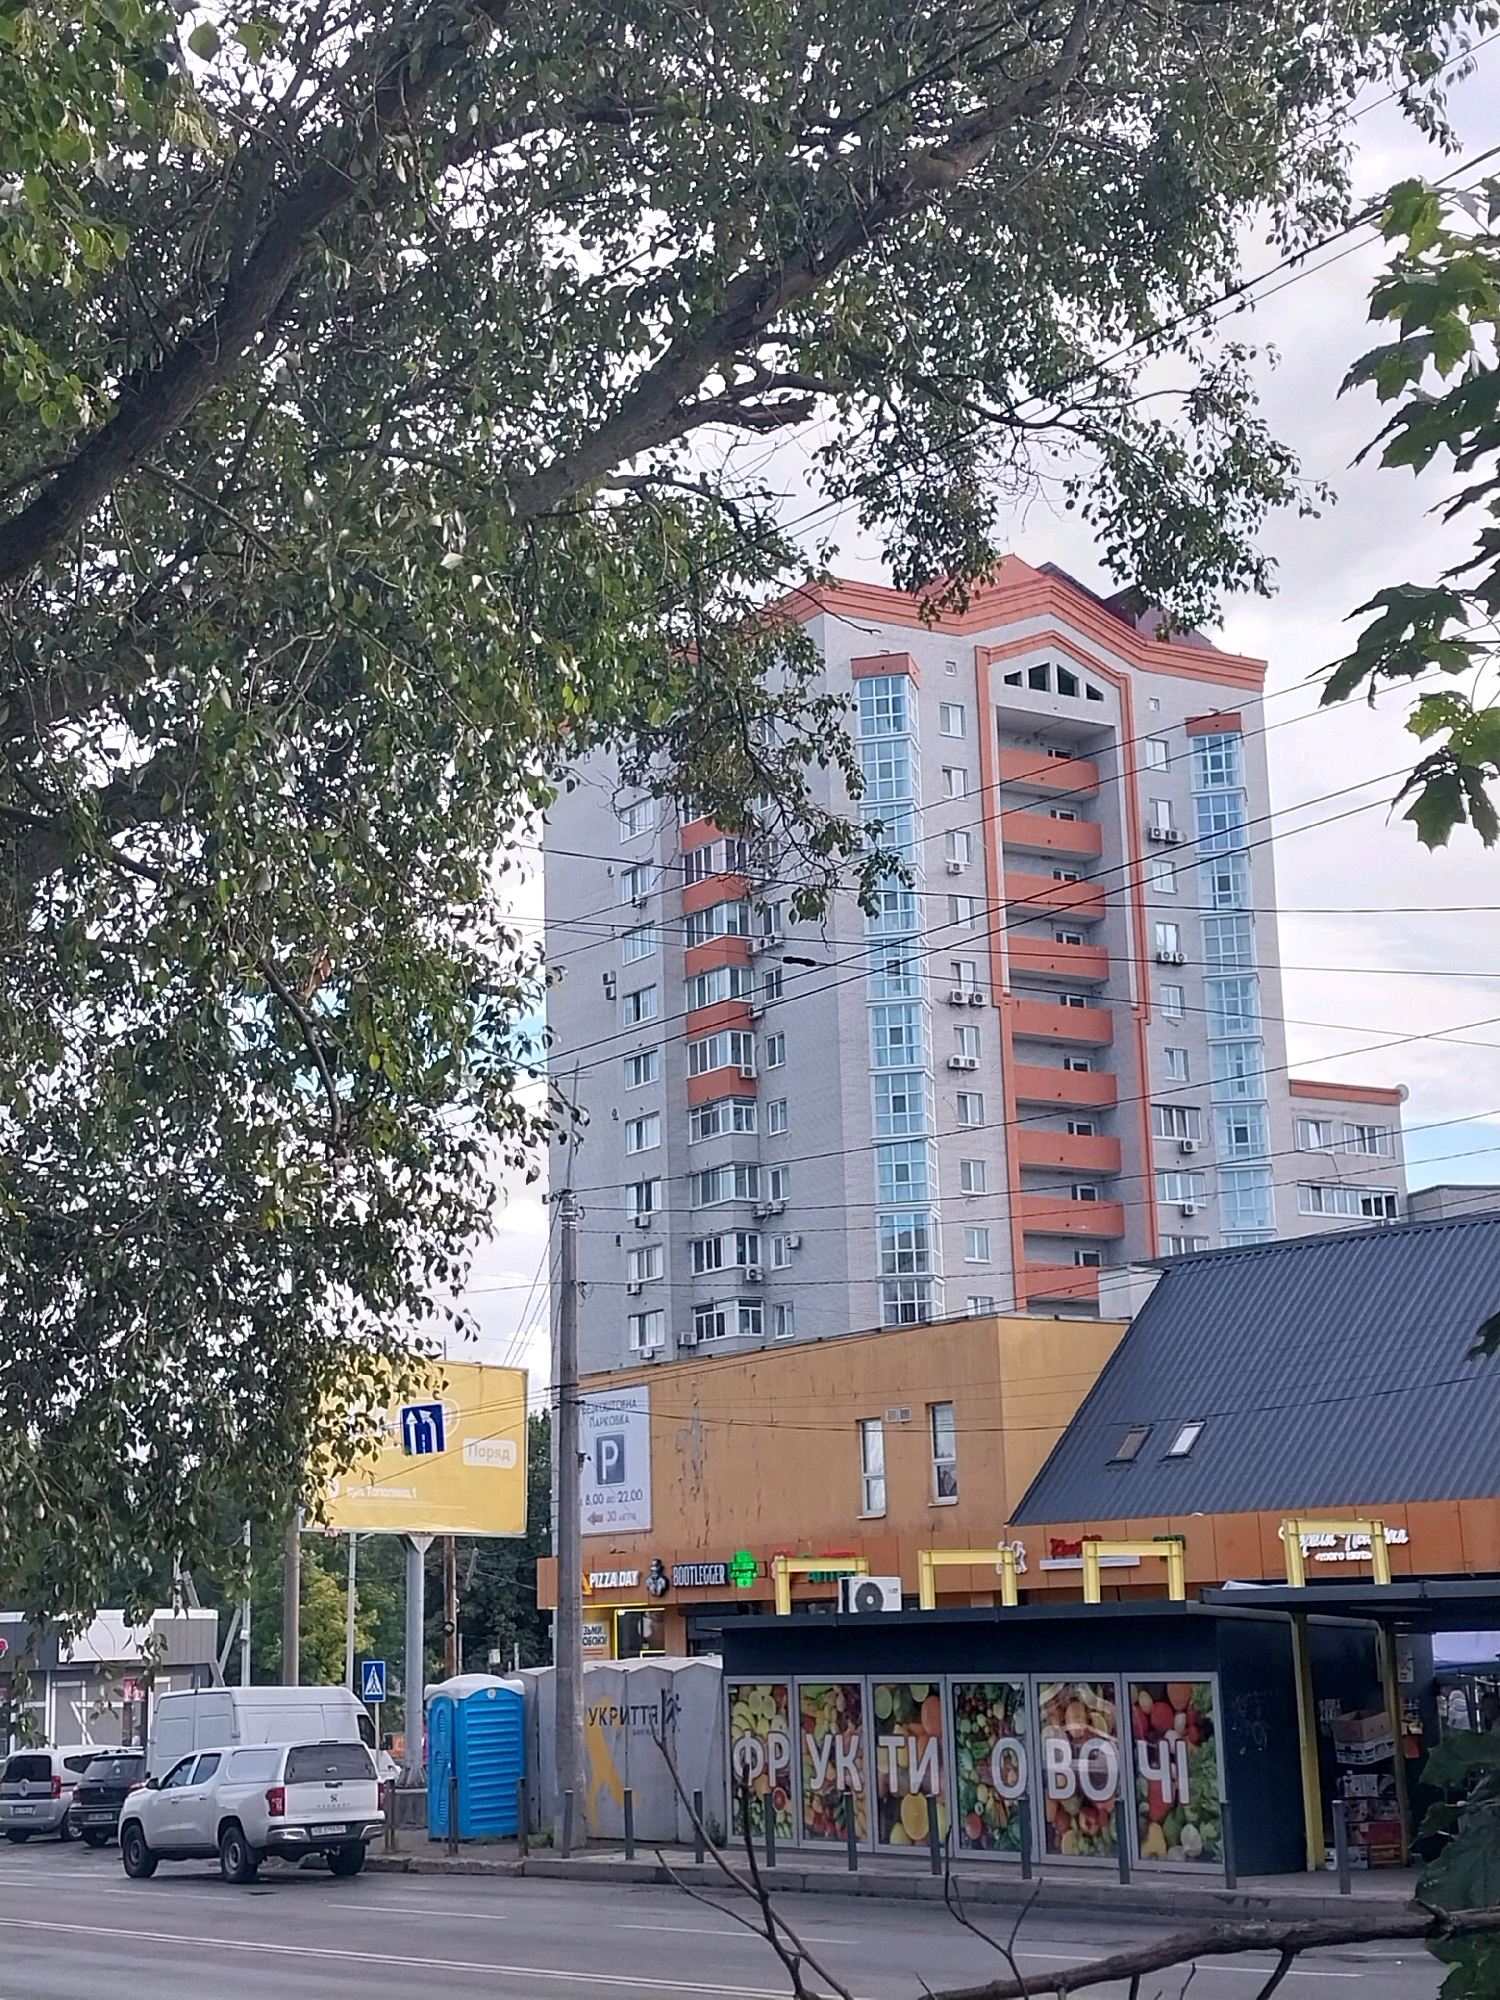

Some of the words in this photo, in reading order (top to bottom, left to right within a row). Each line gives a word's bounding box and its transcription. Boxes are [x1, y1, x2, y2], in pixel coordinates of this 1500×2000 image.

[466, 1443, 511, 1462] Поряд
[589, 1570, 618, 1588] PIZZA
[619, 1570, 639, 1587] DAY
[672, 1563, 726, 1587] BOOTLEGGER
[588, 1704, 659, 1727] УКРИТТЯ
